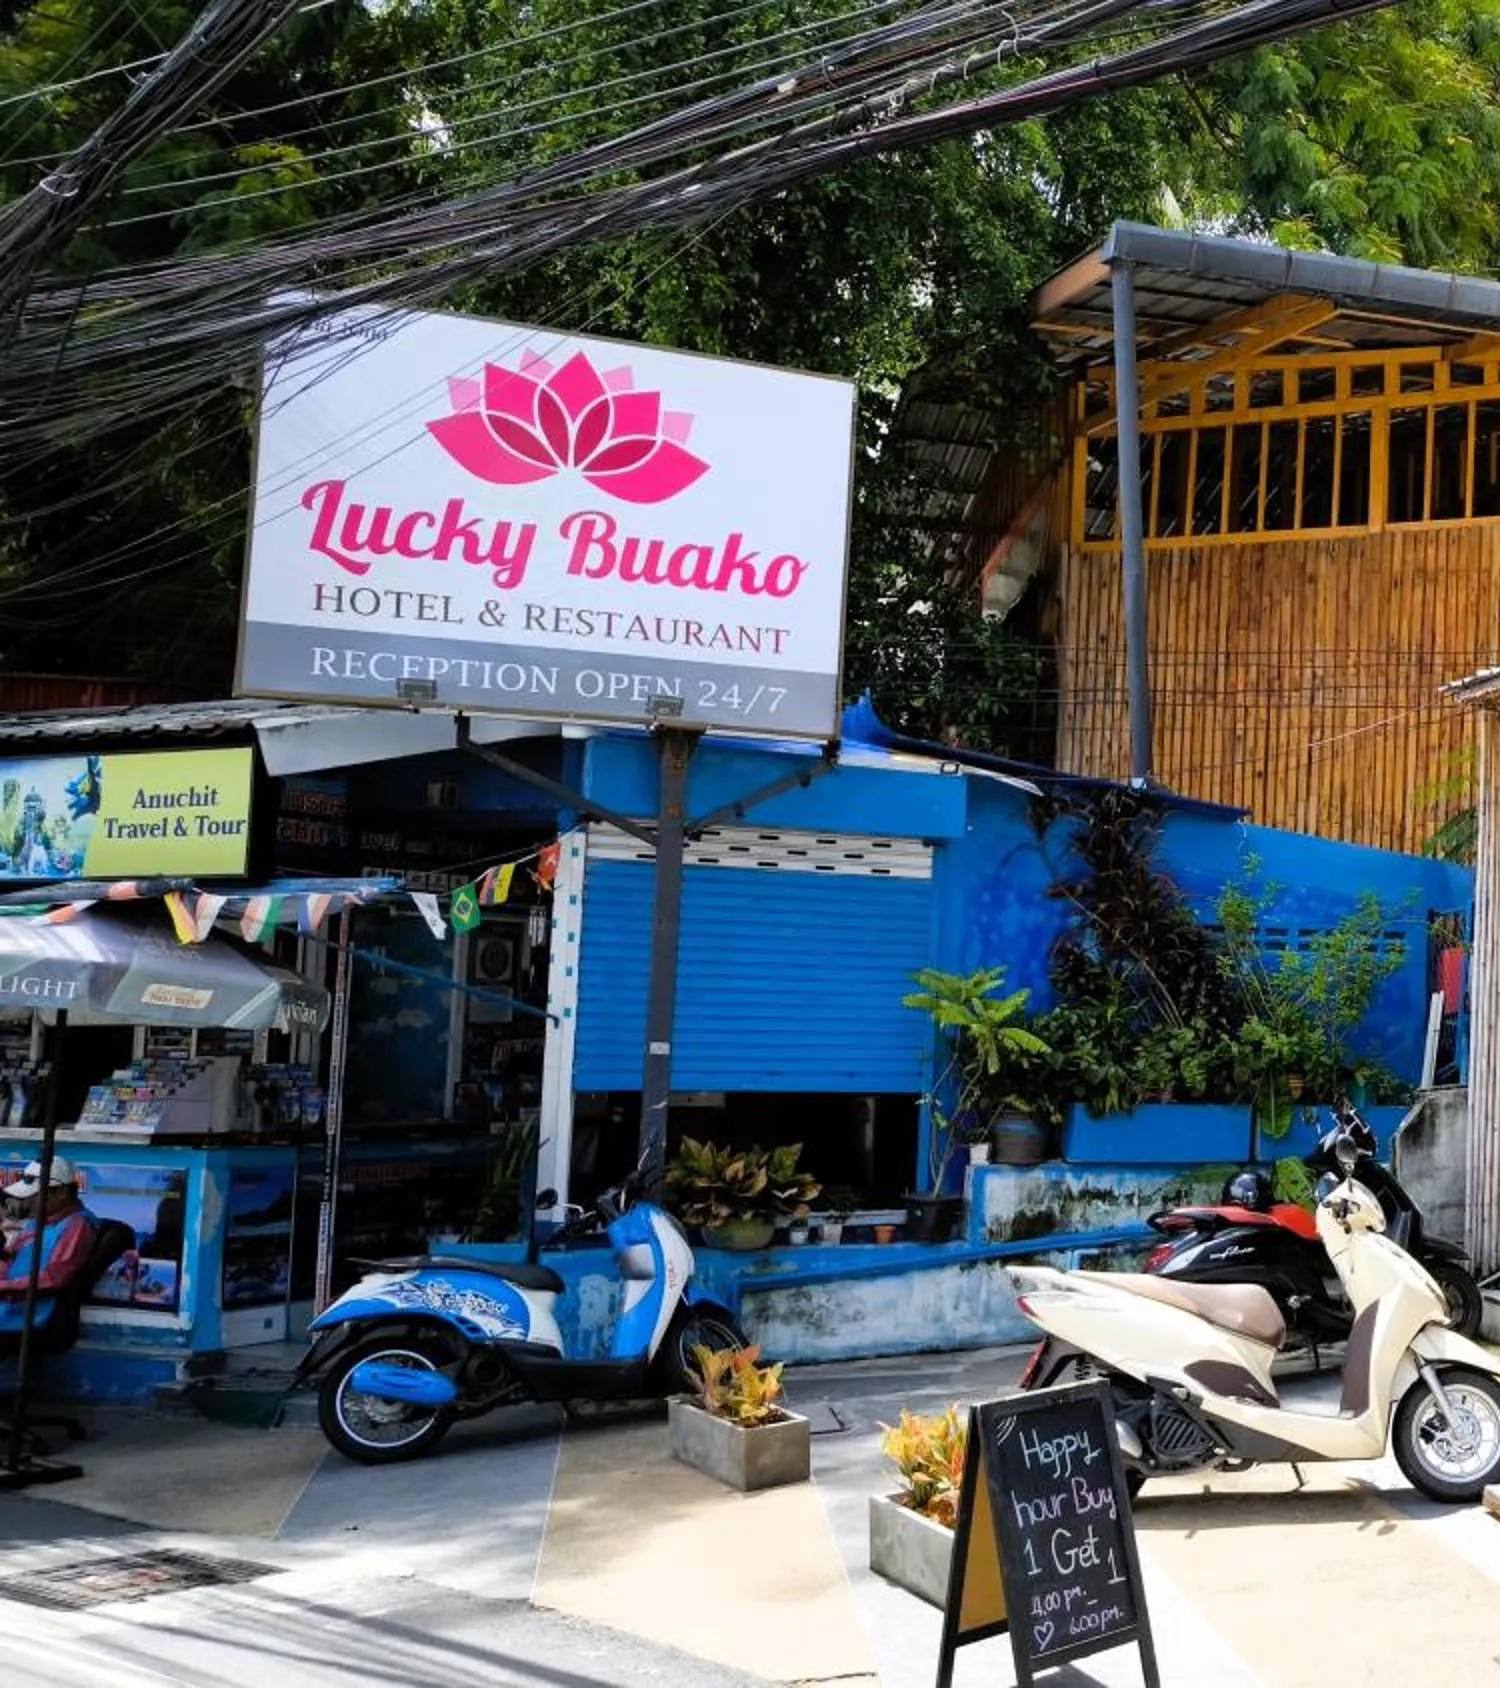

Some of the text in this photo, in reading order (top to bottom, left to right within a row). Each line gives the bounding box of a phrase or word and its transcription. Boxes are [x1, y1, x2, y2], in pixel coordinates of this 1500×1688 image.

[301, 479, 809, 598] Lucky Buako
[312, 583, 791, 655] HOTEL & RESTAURANT
[311, 647, 788, 715] RECEPTION OPEN 24/7
[132, 785, 218, 809] Anuchit
[104, 815, 246, 839] Travel & Tour
[1019, 1427, 1102, 1479] Happy
[1010, 1476, 1117, 1529] hour Buy
[1051, 1525, 1101, 1575] Get
